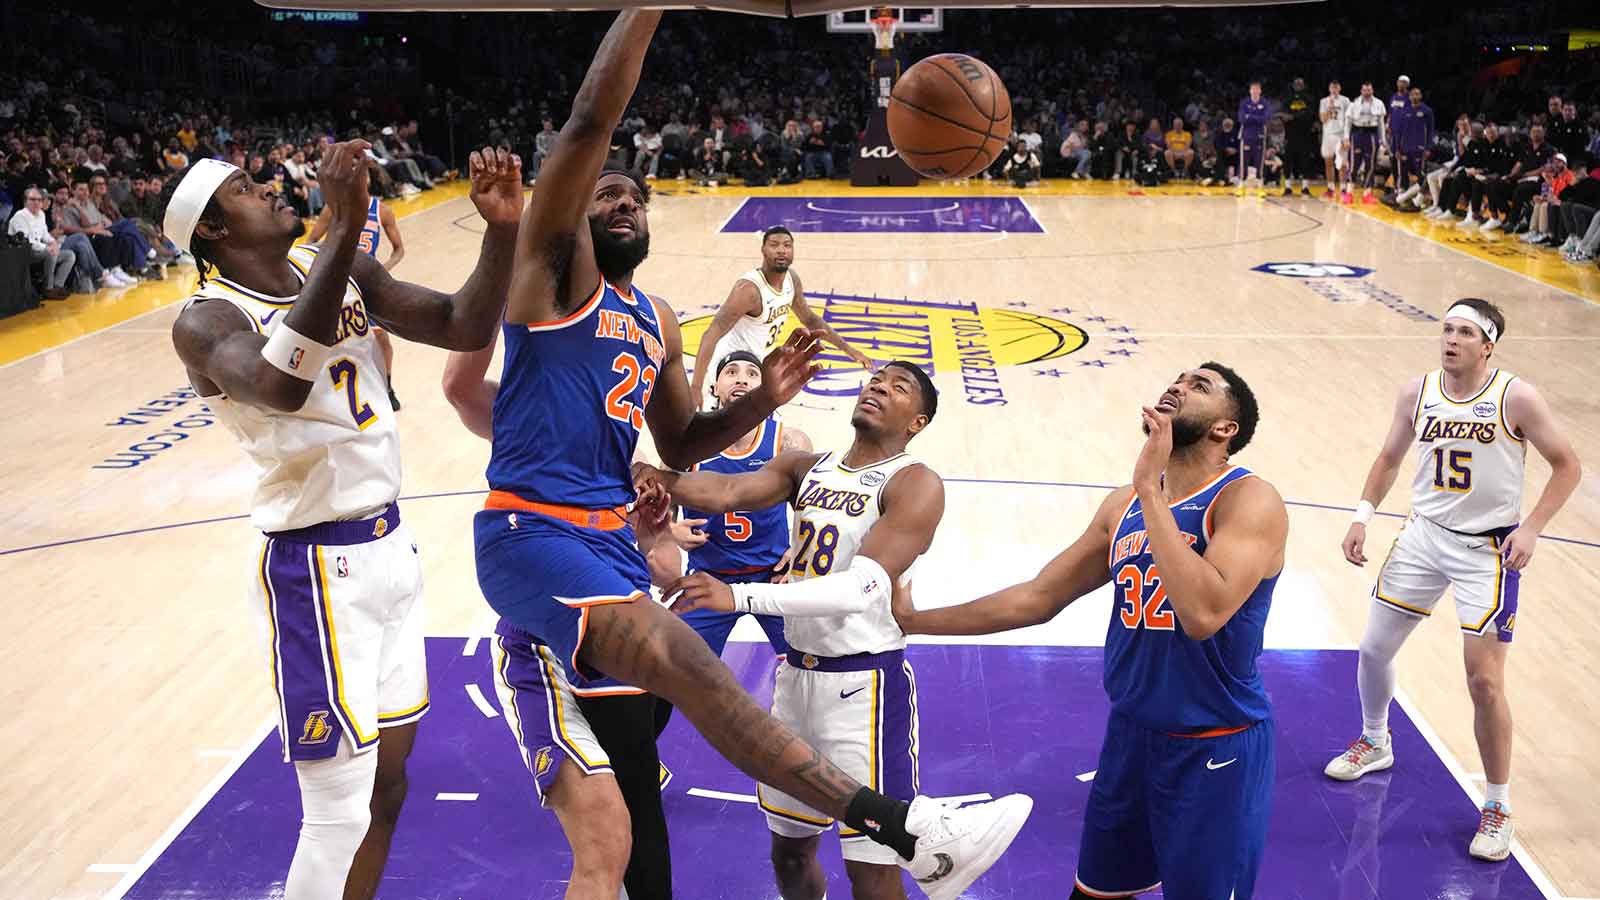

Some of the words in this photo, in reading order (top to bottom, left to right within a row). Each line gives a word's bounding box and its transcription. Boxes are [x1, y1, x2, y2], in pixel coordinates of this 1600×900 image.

[595, 309, 641, 345] NEW
[951, 317, 988, 337] LOS
[605, 351, 658, 434] 23
[954, 338, 1009, 407] ANGELES
[105, 385, 198, 427] RENA
[328, 357, 379, 431] 2
[1418, 415, 1498, 444] LAKERS
[1431, 446, 1473, 494] 15
[796, 480, 871, 518] LAKERS
[725, 511, 753, 542] 5
[790, 519, 840, 578] 28
[1112, 529, 1149, 568] NEW
[1116, 564, 1176, 631] 32
